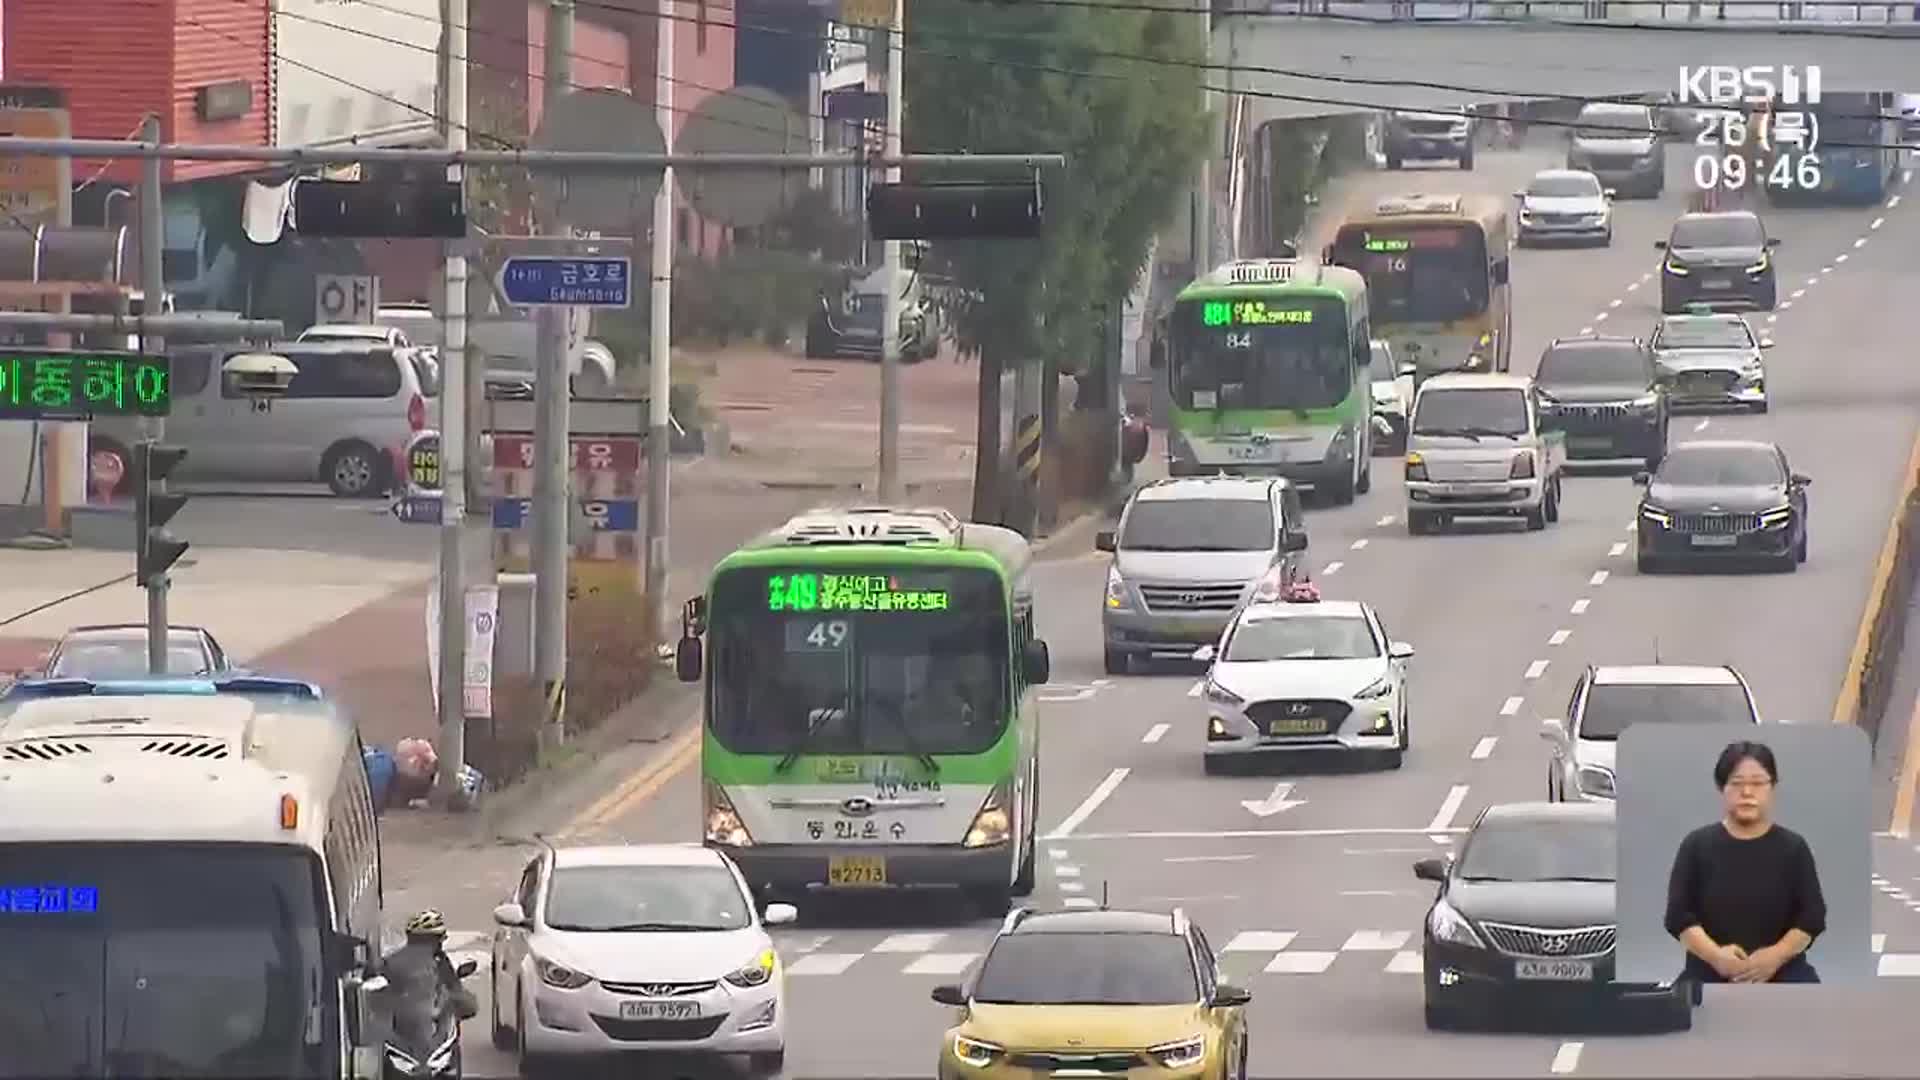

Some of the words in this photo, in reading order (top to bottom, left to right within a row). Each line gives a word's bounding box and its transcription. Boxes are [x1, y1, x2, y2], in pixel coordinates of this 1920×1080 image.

[561, 263, 624, 286] 금호로
[1226, 332, 1251, 349] 84
[807, 621, 848, 647] 49
